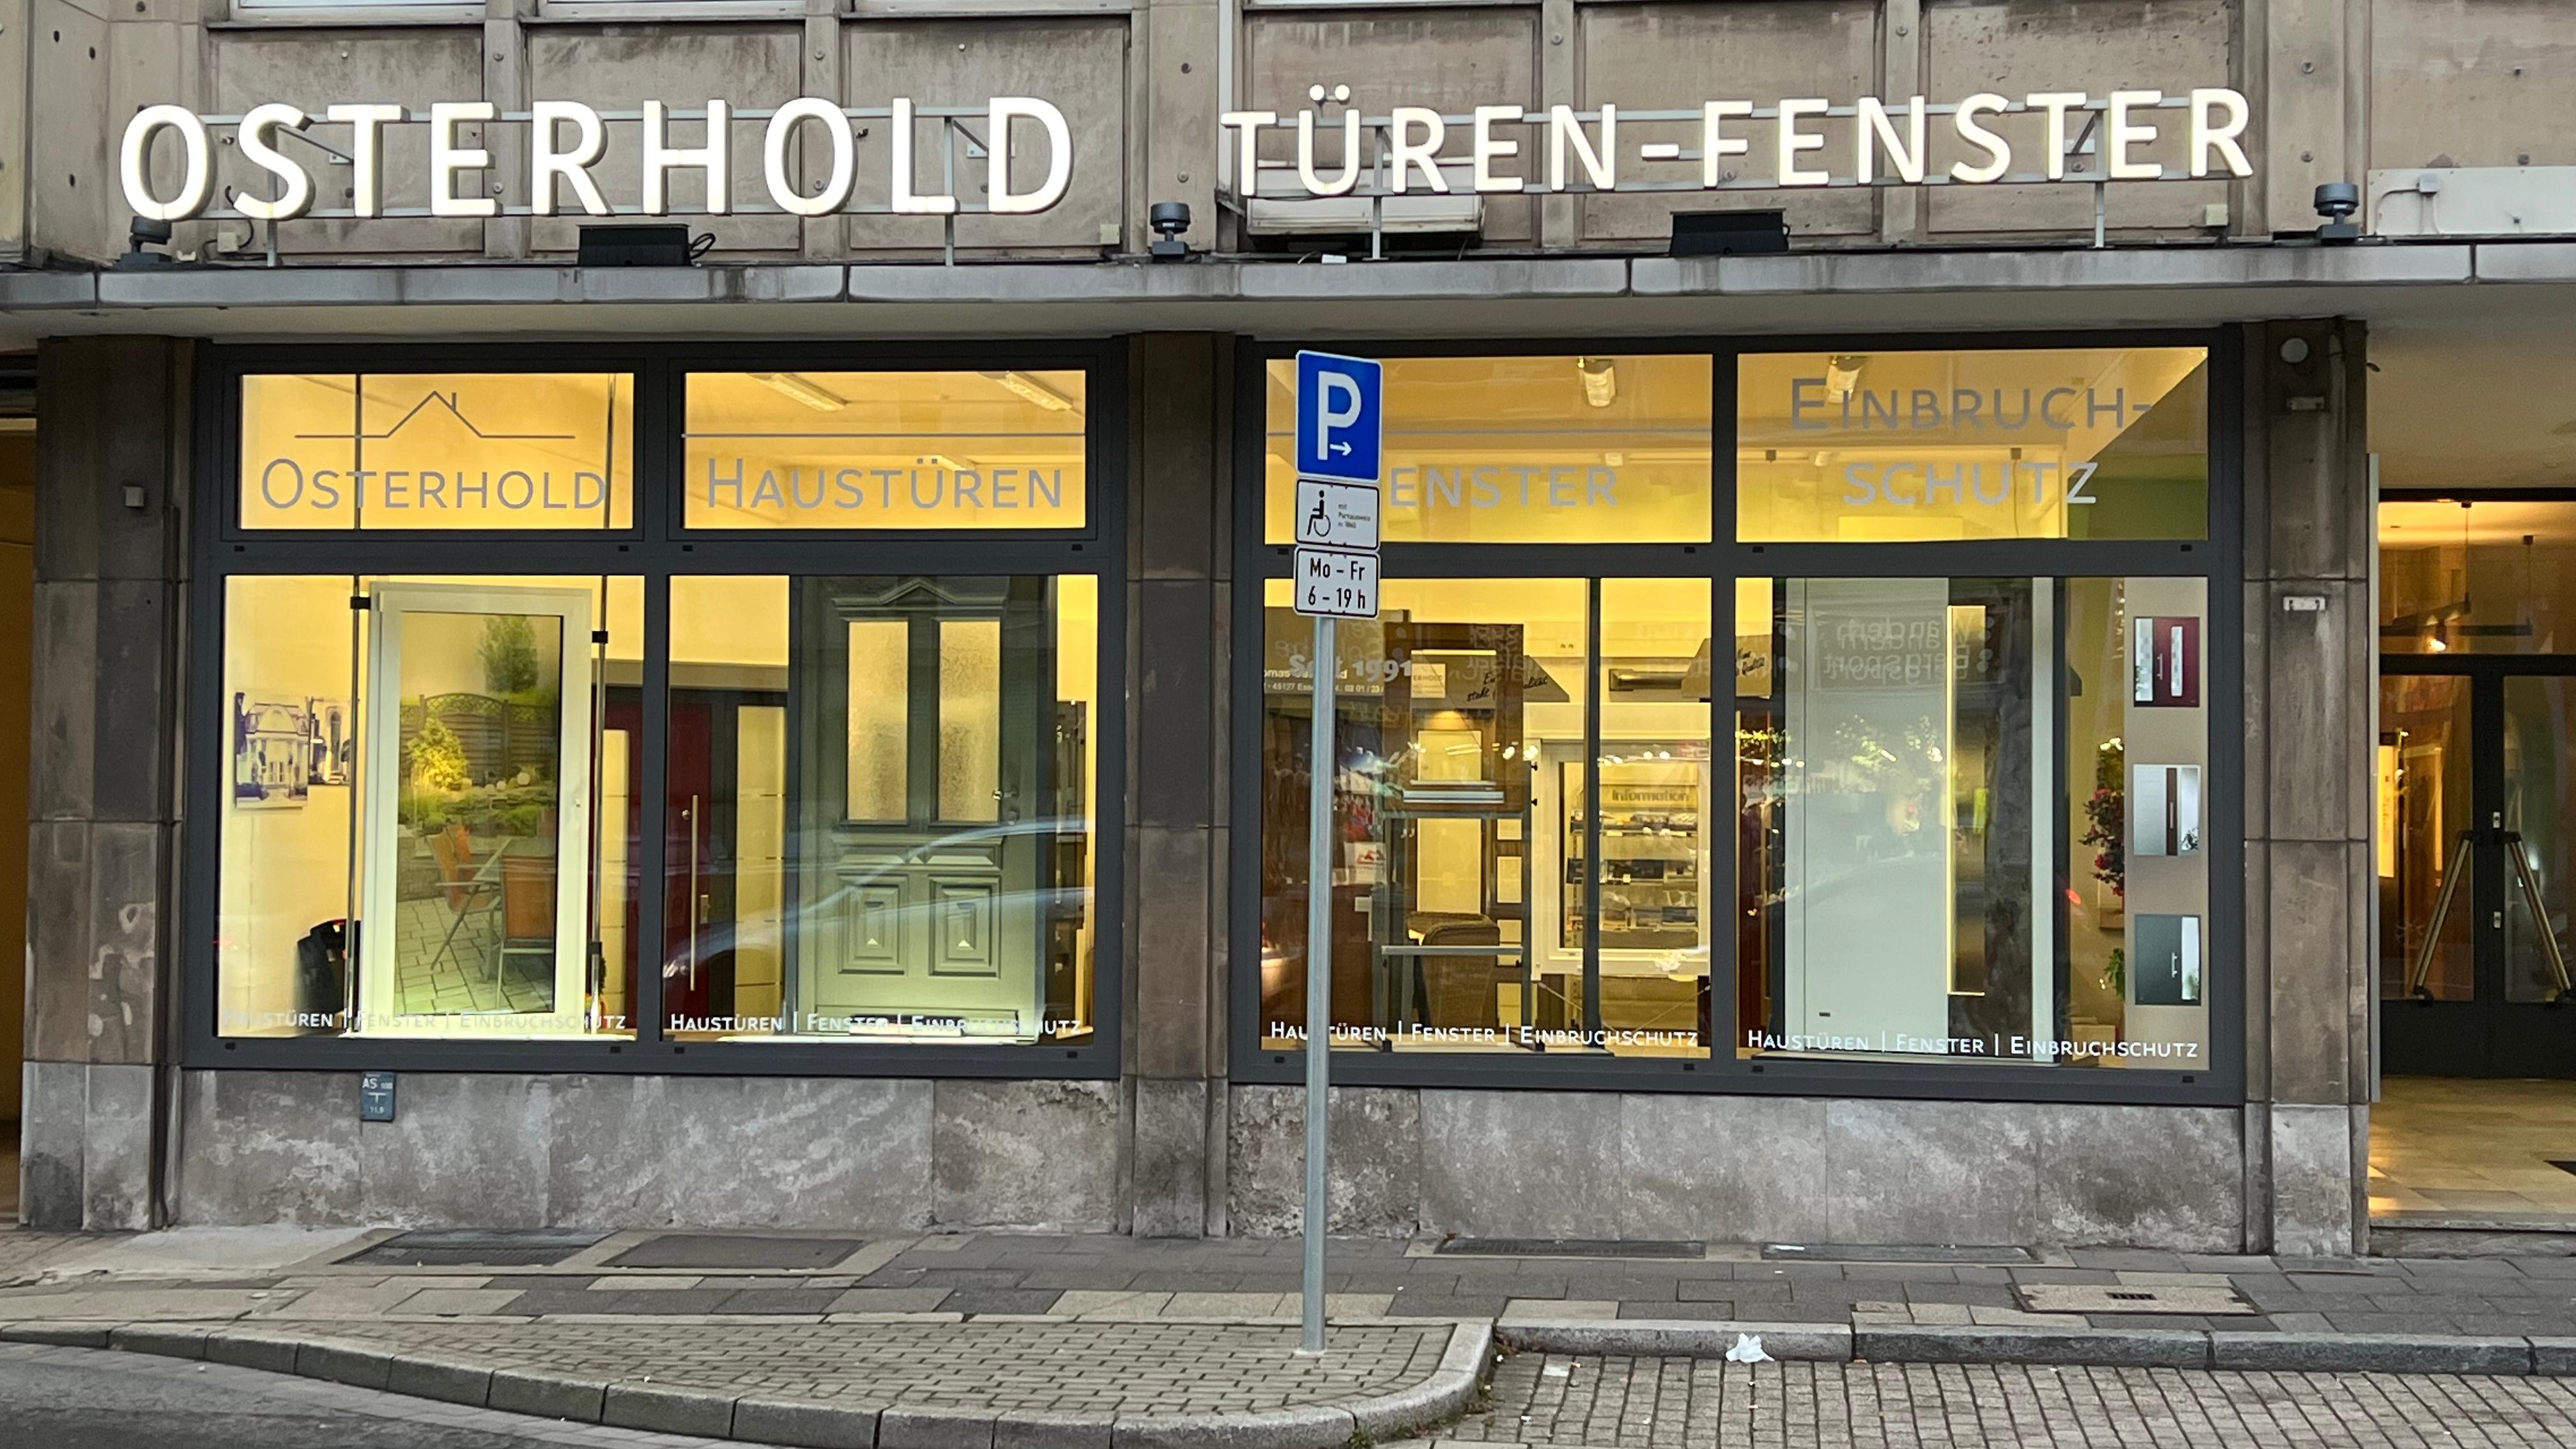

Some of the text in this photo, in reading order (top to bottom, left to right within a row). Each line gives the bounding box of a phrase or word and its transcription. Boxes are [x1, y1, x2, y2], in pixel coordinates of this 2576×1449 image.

[1221, 84, 2253, 197] TÜREN-FENSTER
[119, 96, 1074, 220] OSTERHOLD
[1317, 371, 1361, 460] P
[1390, 466, 1618, 508] ENSTER
[1310, 557, 1330, 578] Mo
[1350, 560, 1365, 581] Fr
[1308, 585, 1315, 606] 6
[1336, 587, 1352, 608] 19
[1358, 588, 1365, 610] h
[1352, 659, 1412, 683] 1991
[1612, 788, 1690, 801] Information
[1271, 1020, 1386, 1041] HAUTÜREN
[362, 1078, 378, 1089] AS
